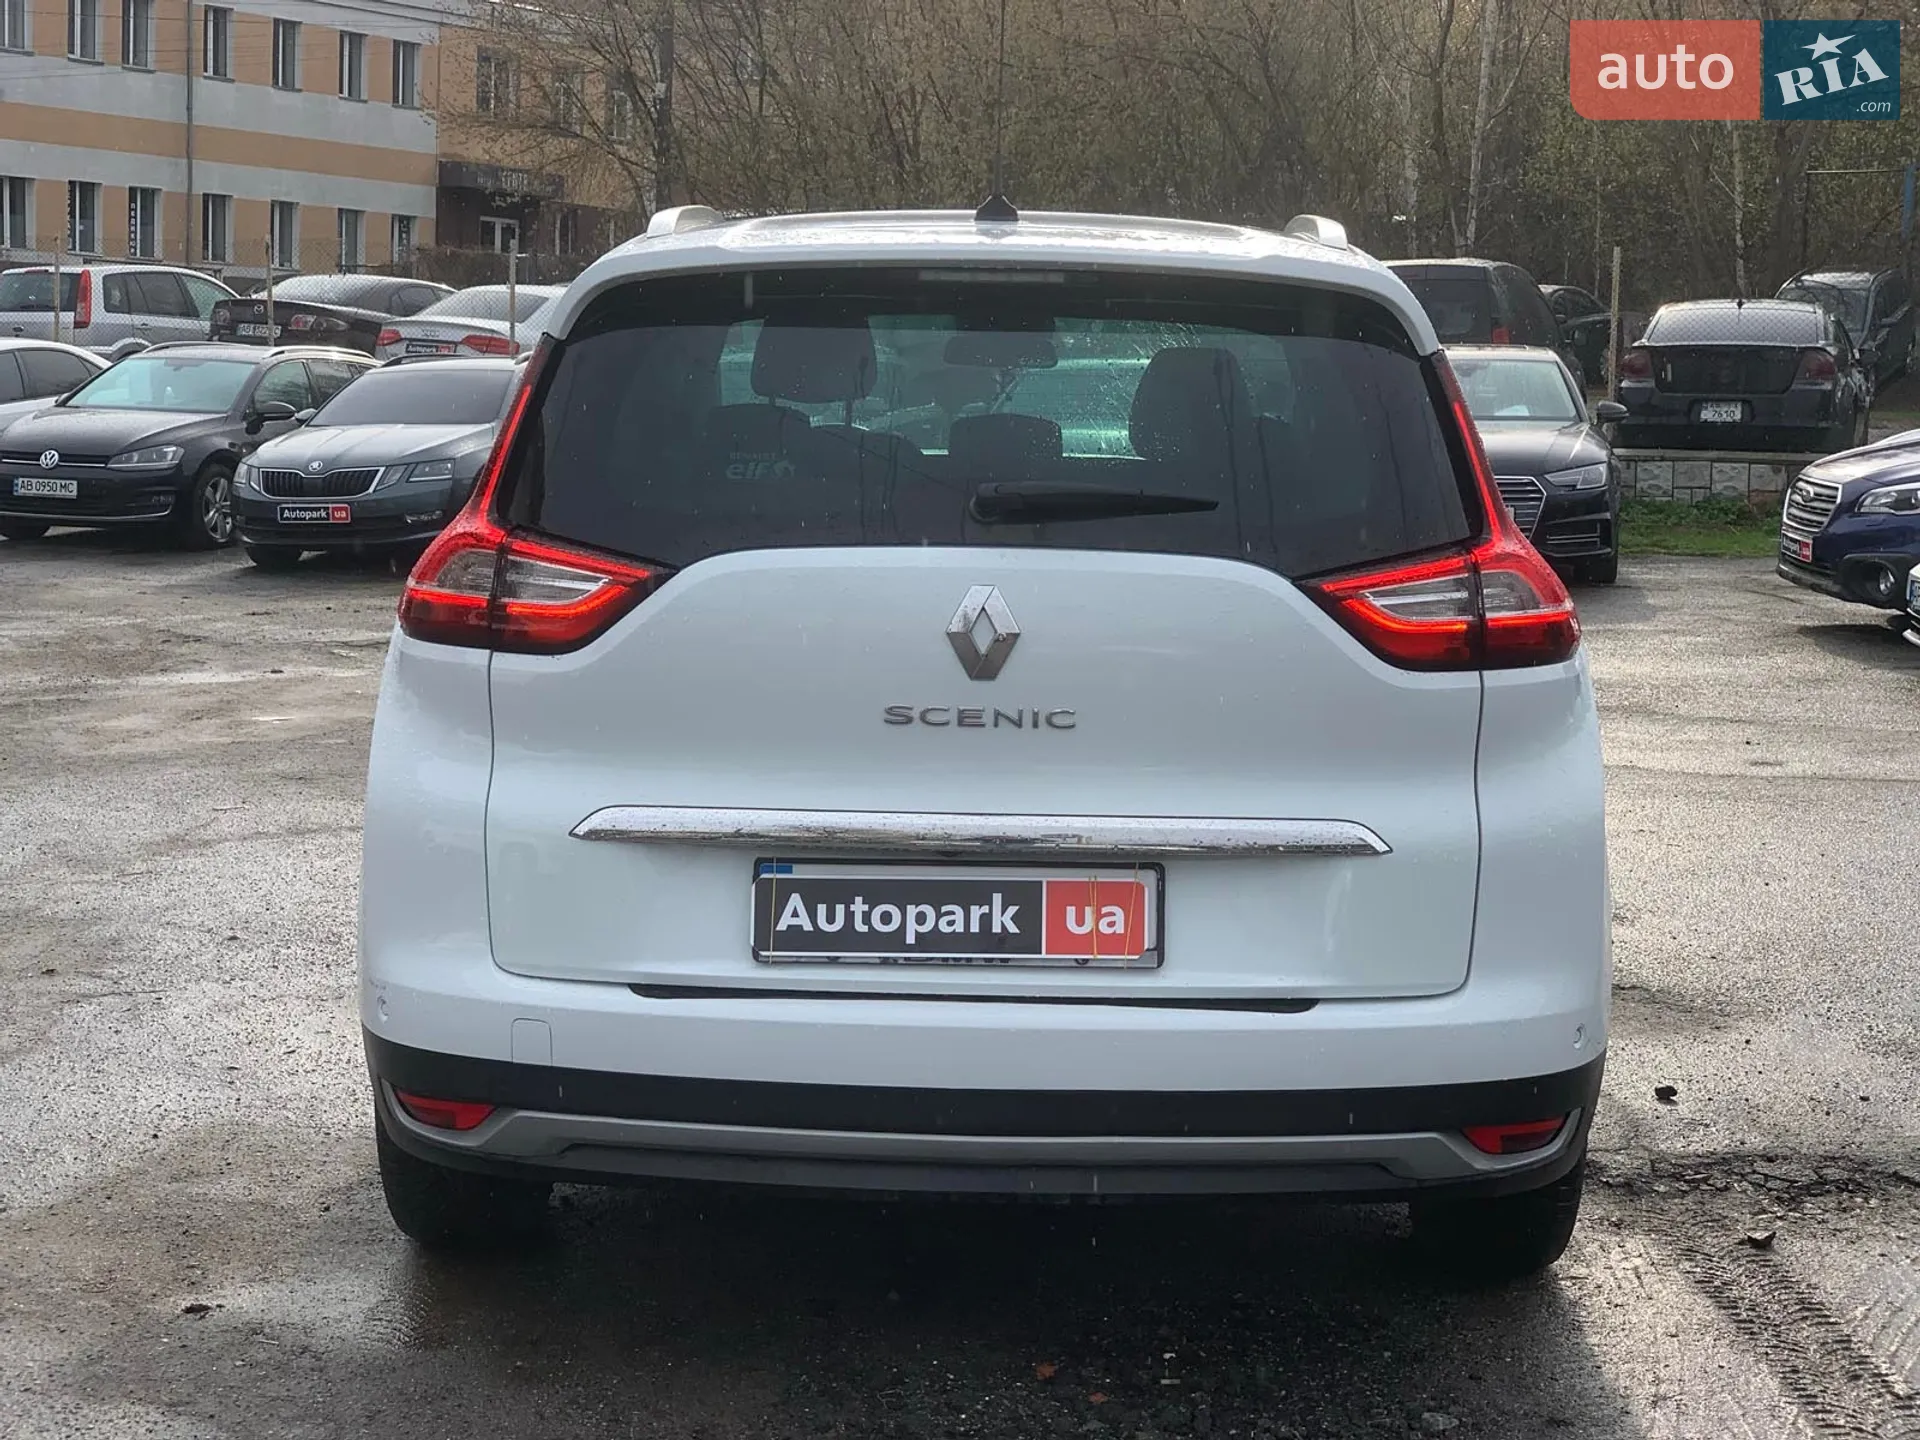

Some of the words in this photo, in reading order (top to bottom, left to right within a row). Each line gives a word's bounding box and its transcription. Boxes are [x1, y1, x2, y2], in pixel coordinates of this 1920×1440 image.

[20, 480, 33, 491] AB
[35, 480, 58, 492] 0950
[60, 482, 75, 493] MC
[283, 508, 327, 520] Autopark
[334, 510, 347, 518] ua
[883, 702, 1077, 730] SCENIC
[775, 892, 1021, 945] Autopark
[1065, 903, 1125, 935] ua
